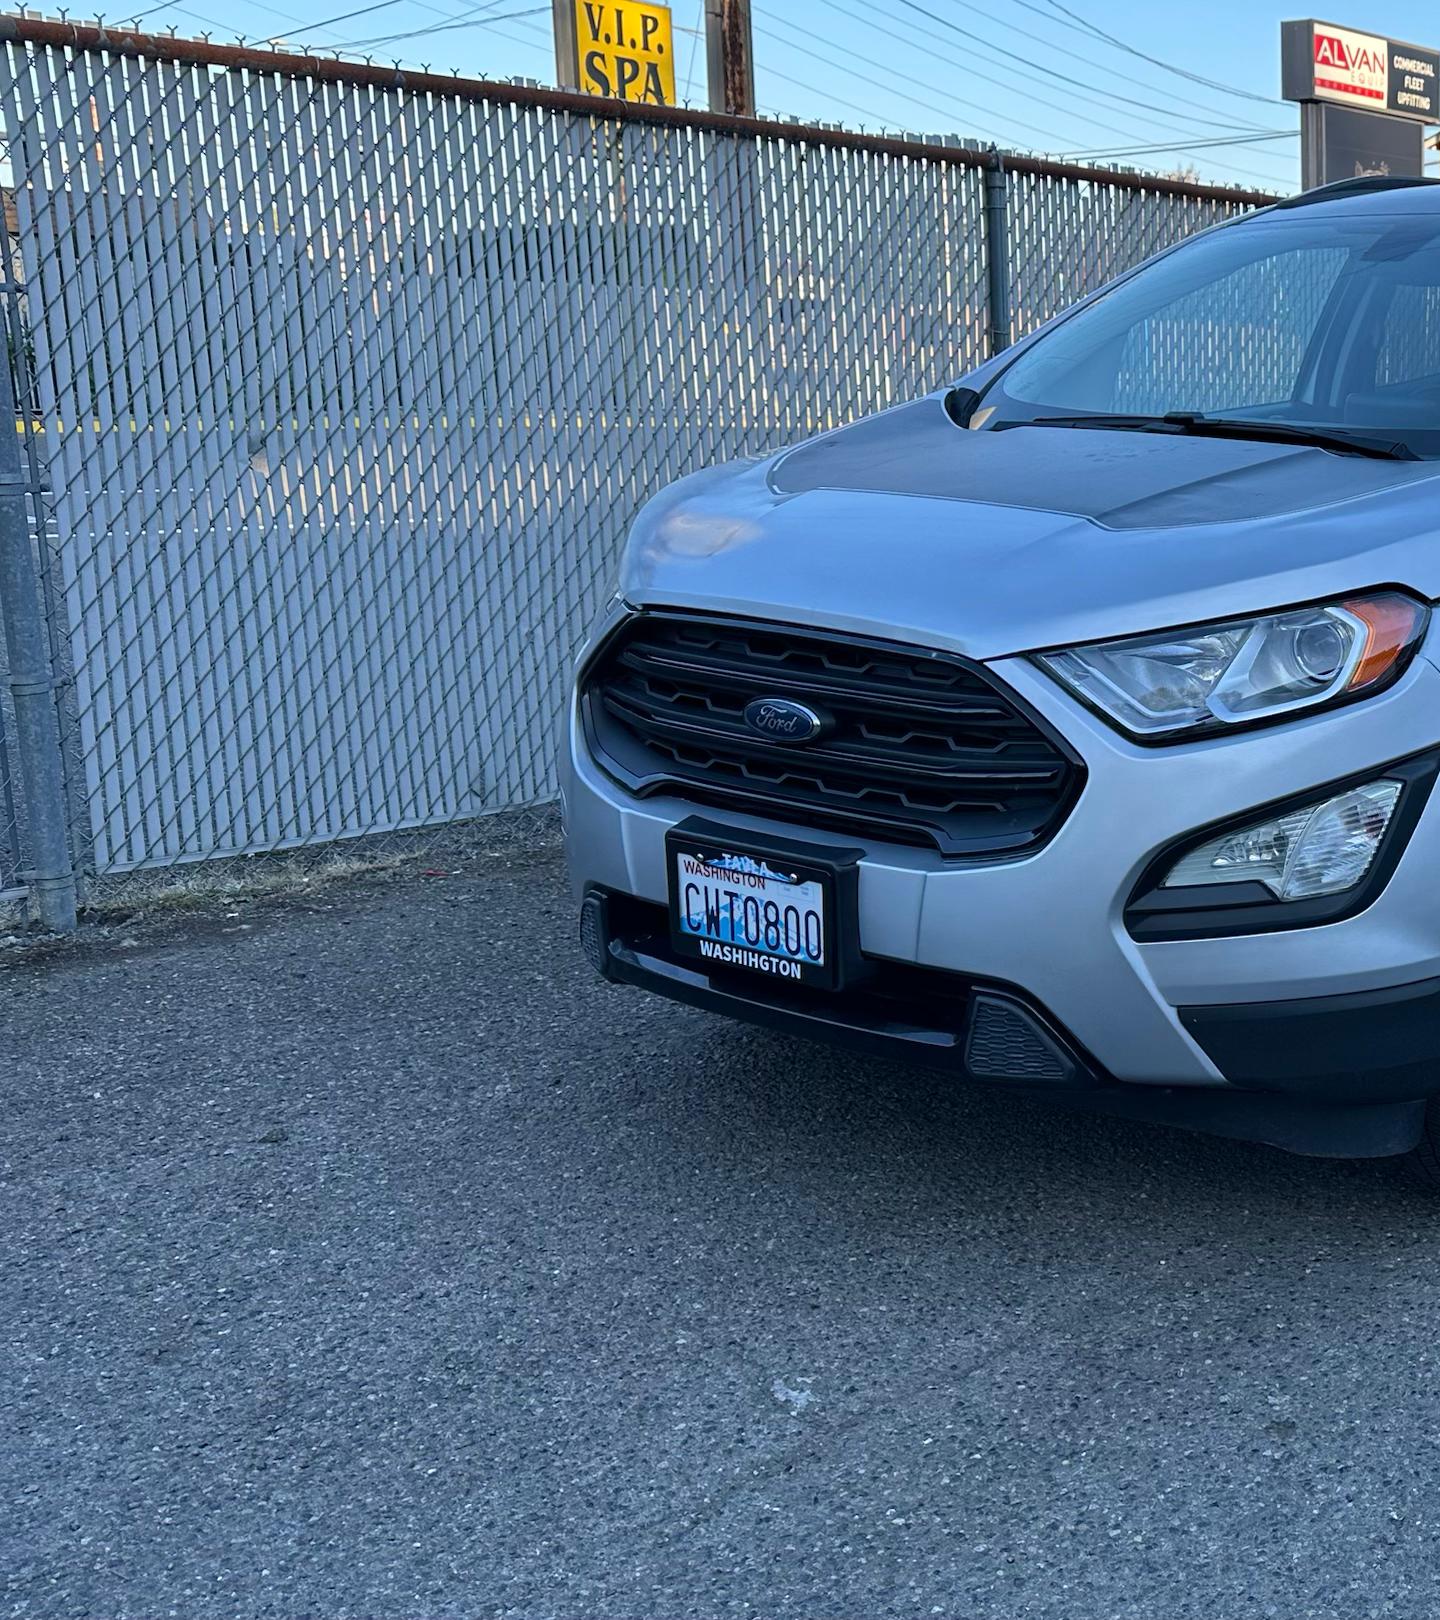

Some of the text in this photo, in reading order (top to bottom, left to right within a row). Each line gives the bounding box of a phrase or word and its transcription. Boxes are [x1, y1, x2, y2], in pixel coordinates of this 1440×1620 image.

[584, 3, 664, 54] V.I.P.
[1316, 37, 1385, 75] ALVAN
[1393, 55, 1435, 77] COMMERCIAL
[585, 51, 666, 105] SPA
[1404, 75, 1425, 91] FLEET
[1397, 91, 1431, 110] UPFITTING
[756, 705, 798, 733] Ford
[684, 860, 766, 890] WASHINGTON
